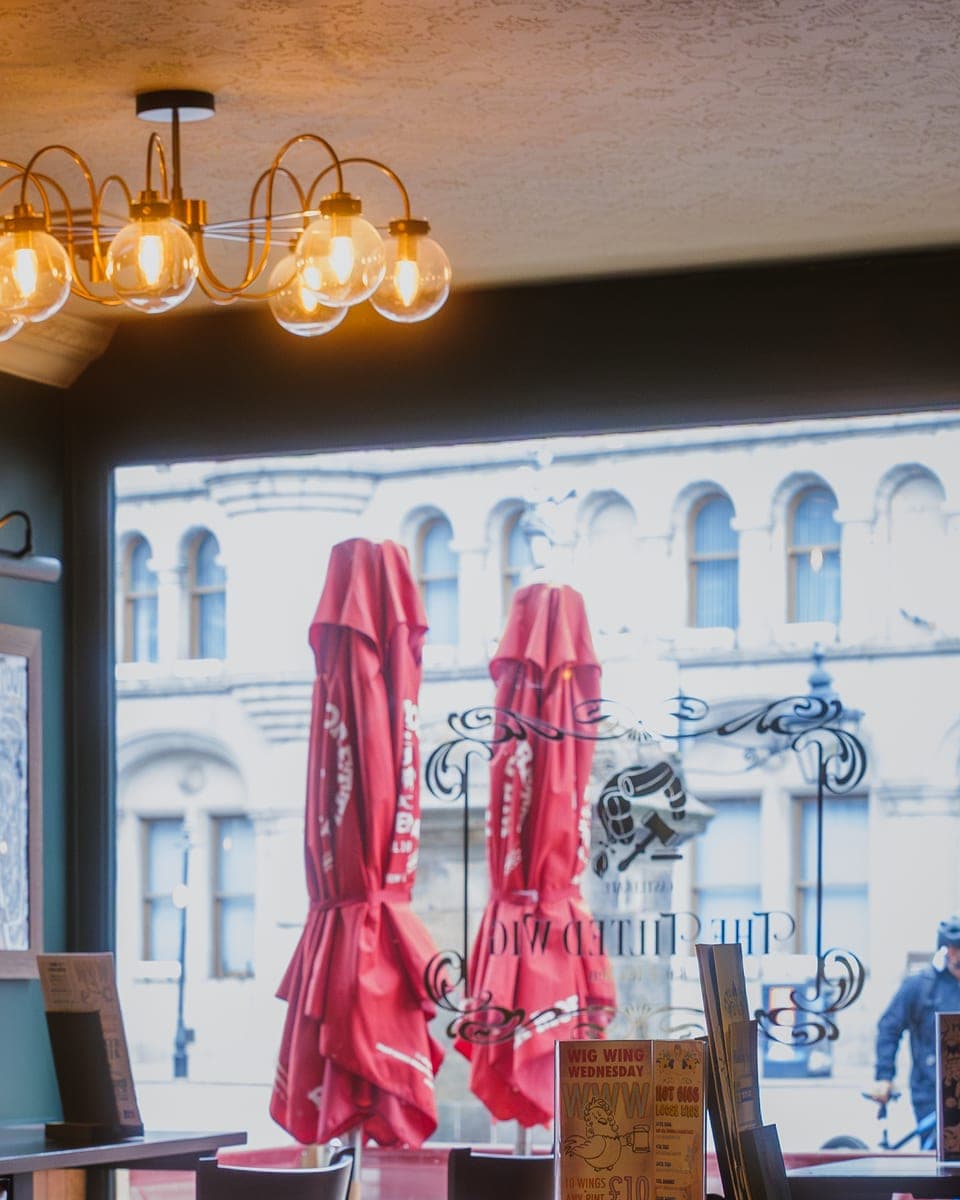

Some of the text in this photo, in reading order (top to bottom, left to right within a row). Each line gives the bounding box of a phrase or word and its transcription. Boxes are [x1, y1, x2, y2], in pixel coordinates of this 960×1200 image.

[568, 1047, 645, 1063] WIG WING
[568, 1065, 644, 1079] WEDNESDAY
[577, 1177, 607, 1189] WINGS
